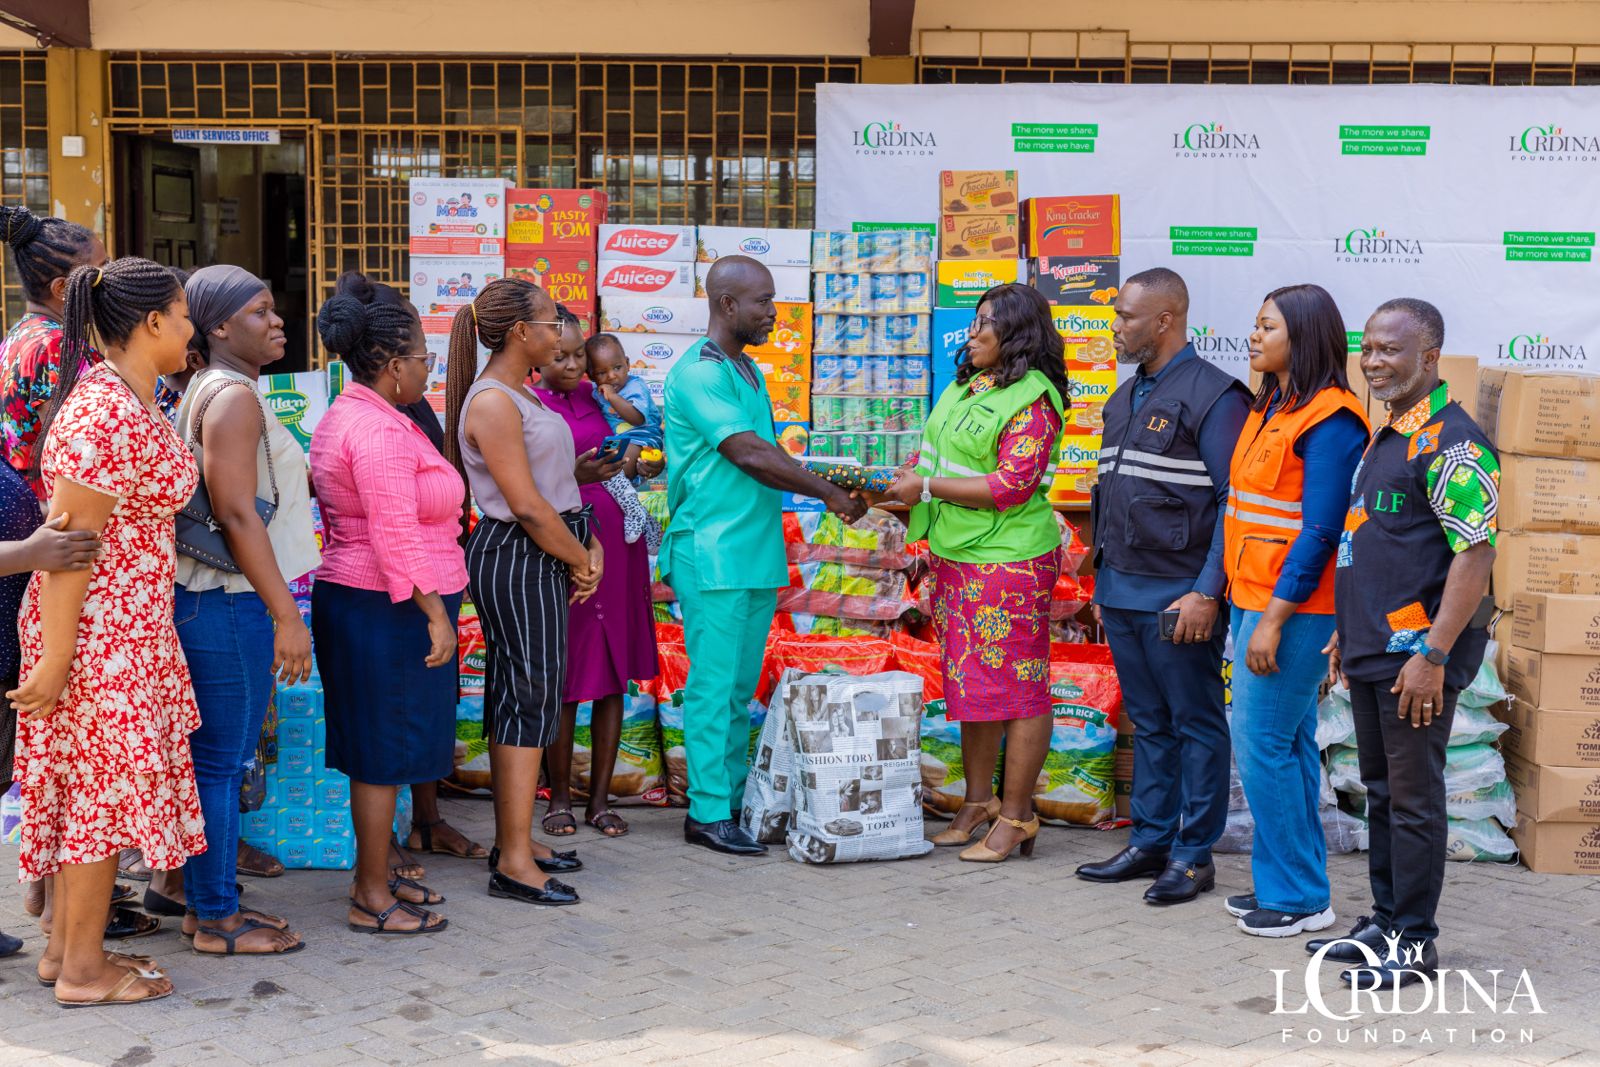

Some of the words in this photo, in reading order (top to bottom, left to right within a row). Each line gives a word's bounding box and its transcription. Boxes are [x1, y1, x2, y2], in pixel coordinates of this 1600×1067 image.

[173, 129, 200, 140] CLIENT
[202, 130, 240, 141] SERVICES
[242, 131, 270, 142] OFFICE
[853, 122, 936, 148] LORDINA
[1173, 124, 1260, 150] LORDINA
[1510, 126, 1600, 154] LORDINA
[960, 176, 1000, 197] Chocolate
[552, 210, 589, 221] TASTY
[1045, 207, 1066, 223] King
[1069, 209, 1100, 220] Cracker
[550, 221, 590, 237] TOM
[961, 221, 1001, 241] Chocolate
[611, 234, 668, 248] Juicee
[1334, 228, 1423, 255] LORDINA
[549, 273, 585, 285] TASTY
[609, 271, 666, 285] Juicee
[953, 279, 987, 289] Granola
[548, 285, 588, 301] TOM
[1052, 314, 1109, 332] triSnax
[1497, 335, 1587, 362] LORDINA
[965, 420, 985, 437] LF
[1147, 416, 1168, 432] LF
[1257, 450, 1271, 462] LF
[1374, 491, 1406, 513] LF
[1076, 708, 1094, 719] RICE
[844, 754, 873, 764] TORY
[866, 820, 896, 831] TORY
